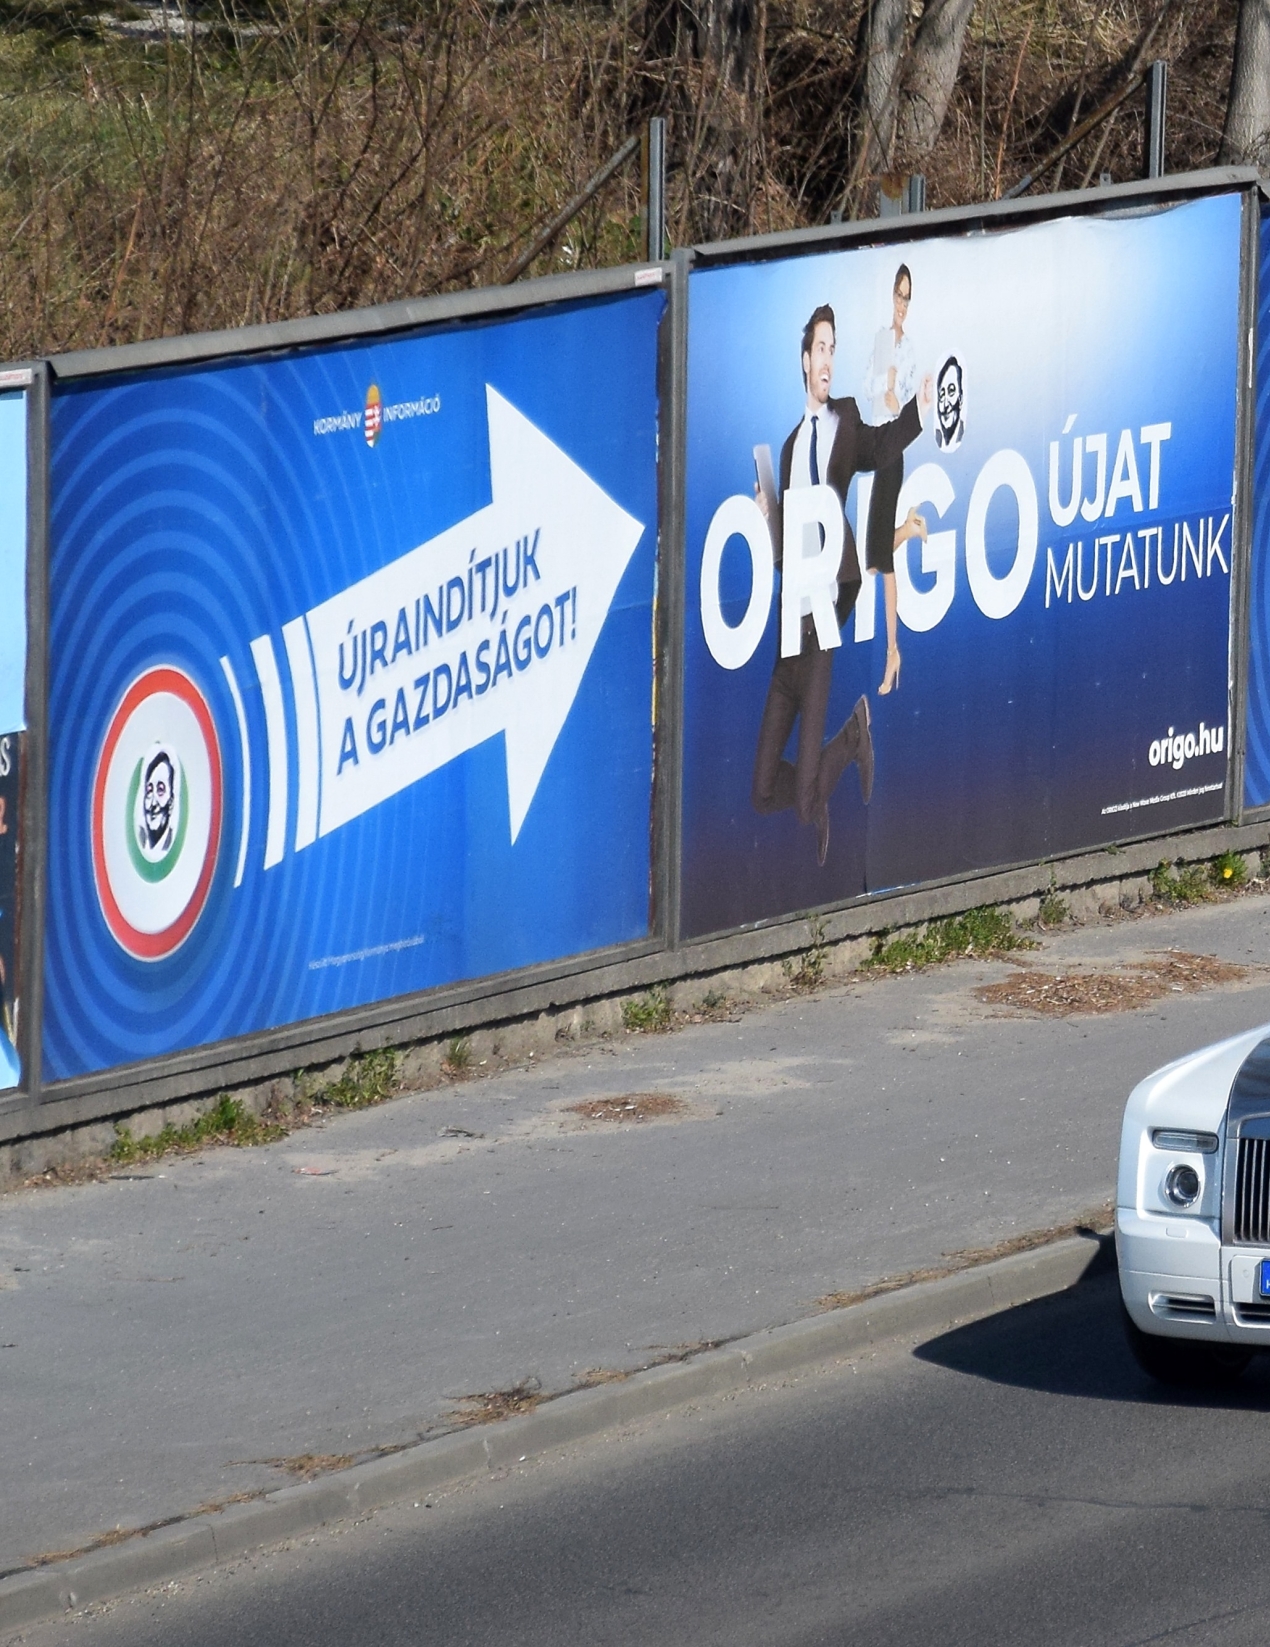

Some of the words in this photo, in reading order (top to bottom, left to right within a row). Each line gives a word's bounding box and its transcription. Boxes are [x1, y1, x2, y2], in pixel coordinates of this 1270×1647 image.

[313, 410, 363, 436] KORMÁNY
[383, 393, 441, 422] INFORMÁCIÓ
[1049, 413, 1172, 528] ÚJAT
[337, 526, 542, 697] ÚJRAINDÍTJUK
[700, 448, 1038, 671] ORIGO
[1044, 513, 1230, 609] MUTATUNK
[336, 715, 360, 776] A
[365, 585, 577, 756] GAZDASÁGOT!
[1148, 721, 1224, 770] origo.hu
